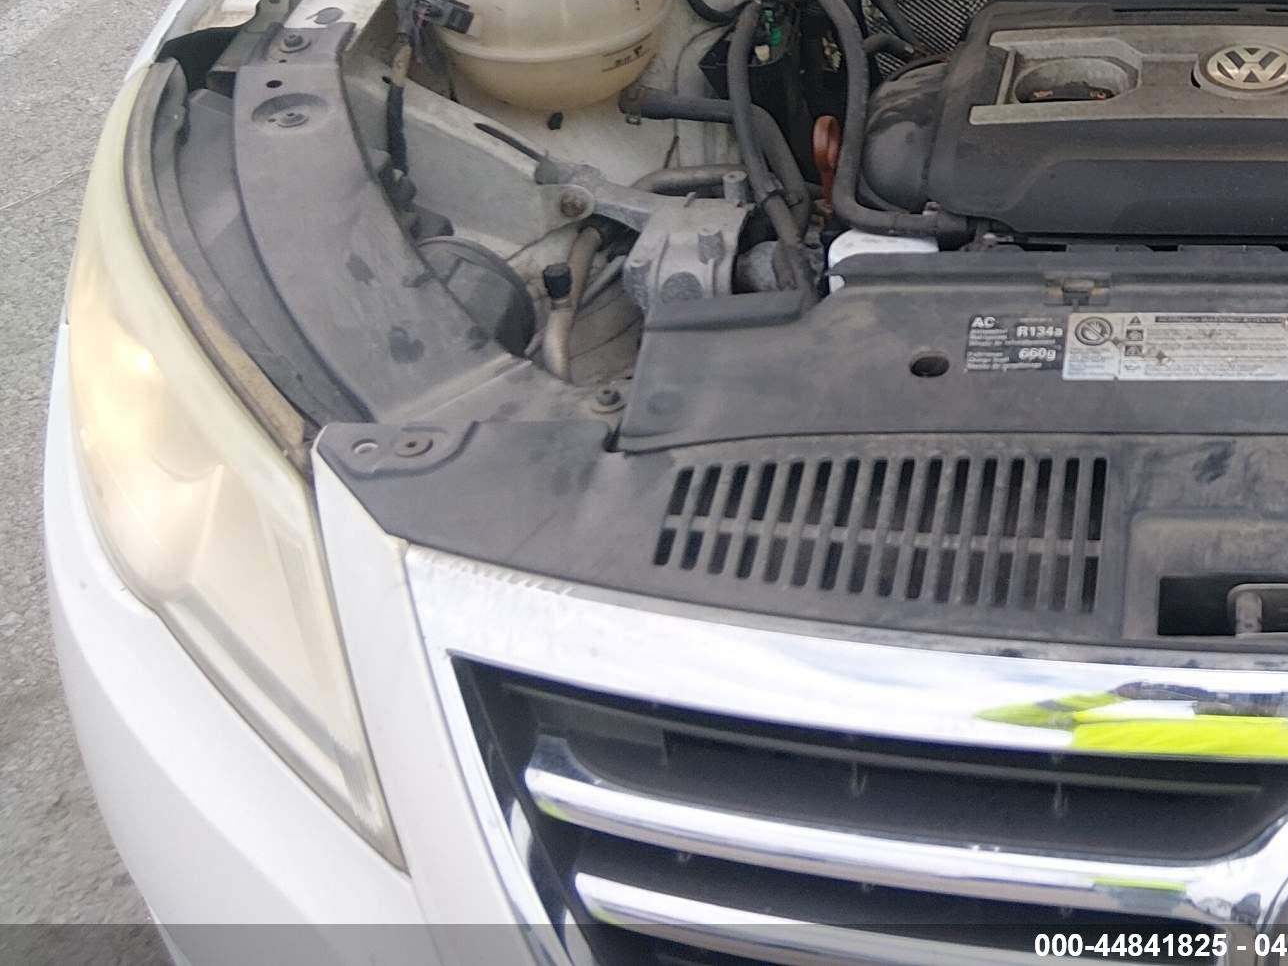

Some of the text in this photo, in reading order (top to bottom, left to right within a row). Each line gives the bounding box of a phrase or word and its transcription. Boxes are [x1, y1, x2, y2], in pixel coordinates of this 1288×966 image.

[971, 316, 997, 329] AC
[1016, 325, 1064, 338] R134a
[1018, 347, 1057, 362] 660g
